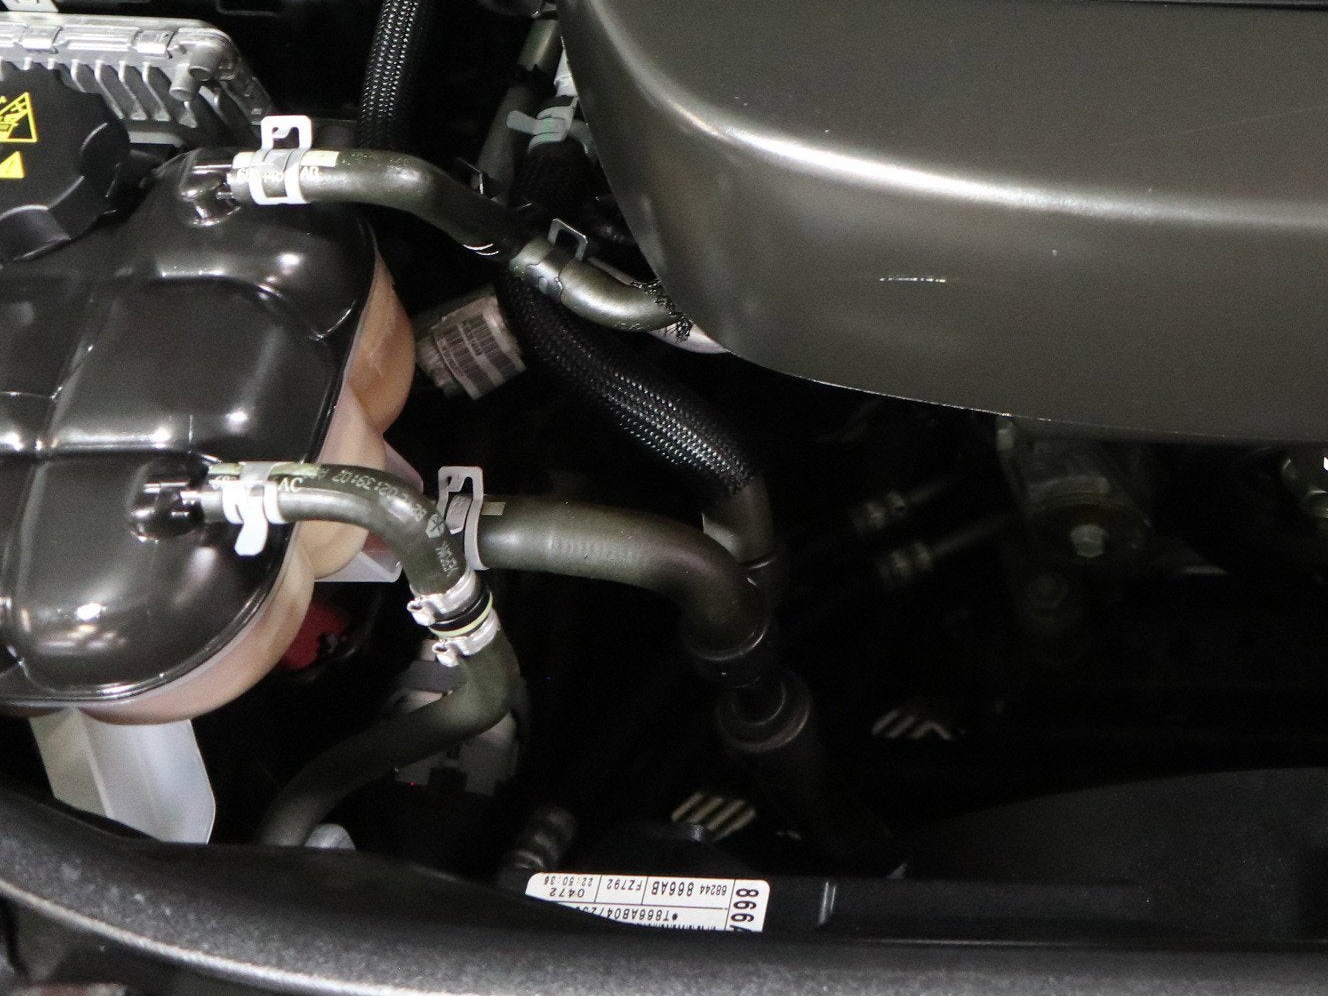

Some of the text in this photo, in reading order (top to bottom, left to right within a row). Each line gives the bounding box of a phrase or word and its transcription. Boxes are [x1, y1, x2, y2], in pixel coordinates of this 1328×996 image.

[606, 878, 643, 891] FZ792
[651, 881, 728, 898] 68244 866AB
[549, 887, 585, 899] 0472
